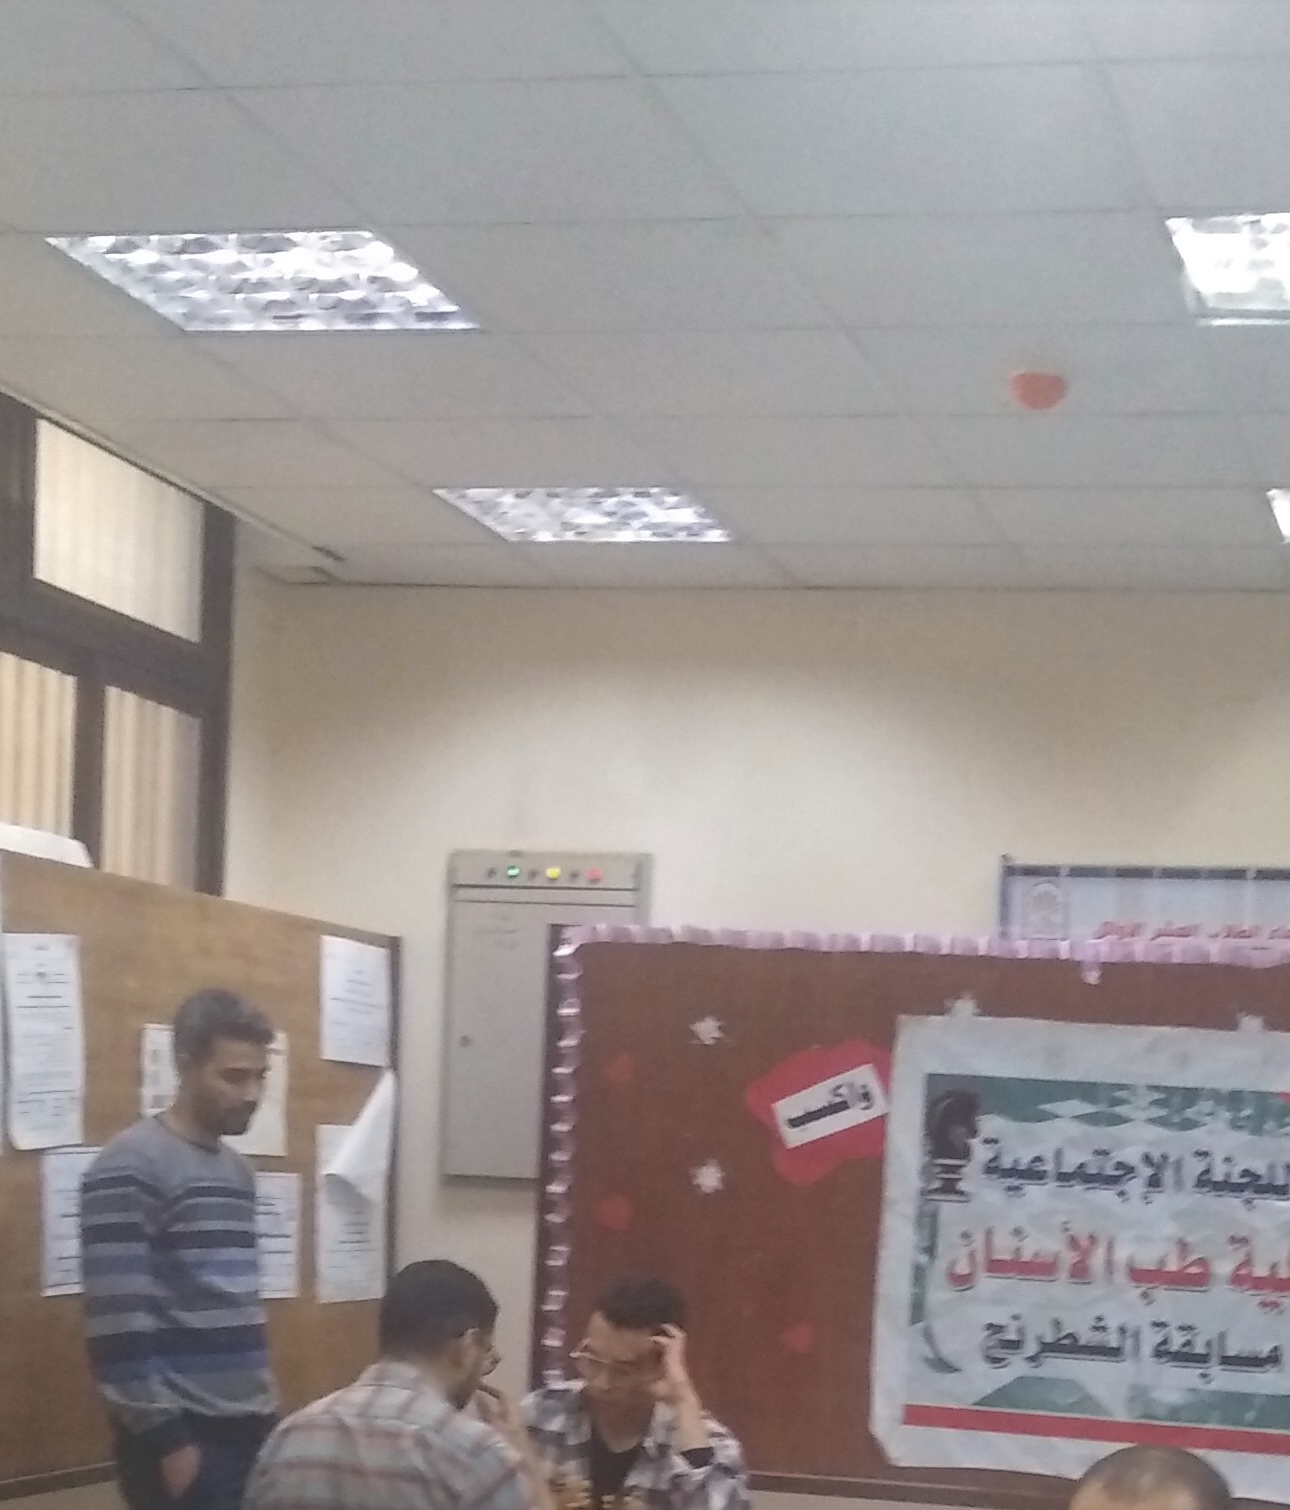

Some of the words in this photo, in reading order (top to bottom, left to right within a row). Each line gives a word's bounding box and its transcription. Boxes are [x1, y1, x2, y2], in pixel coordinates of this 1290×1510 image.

[945, 1220, 1115, 1292] الأسنان
[1127, 1236, 1212, 1305] طب
[981, 1312, 1143, 1370] الشطرنج
[1150, 1319, 1285, 1384] مسابقة
